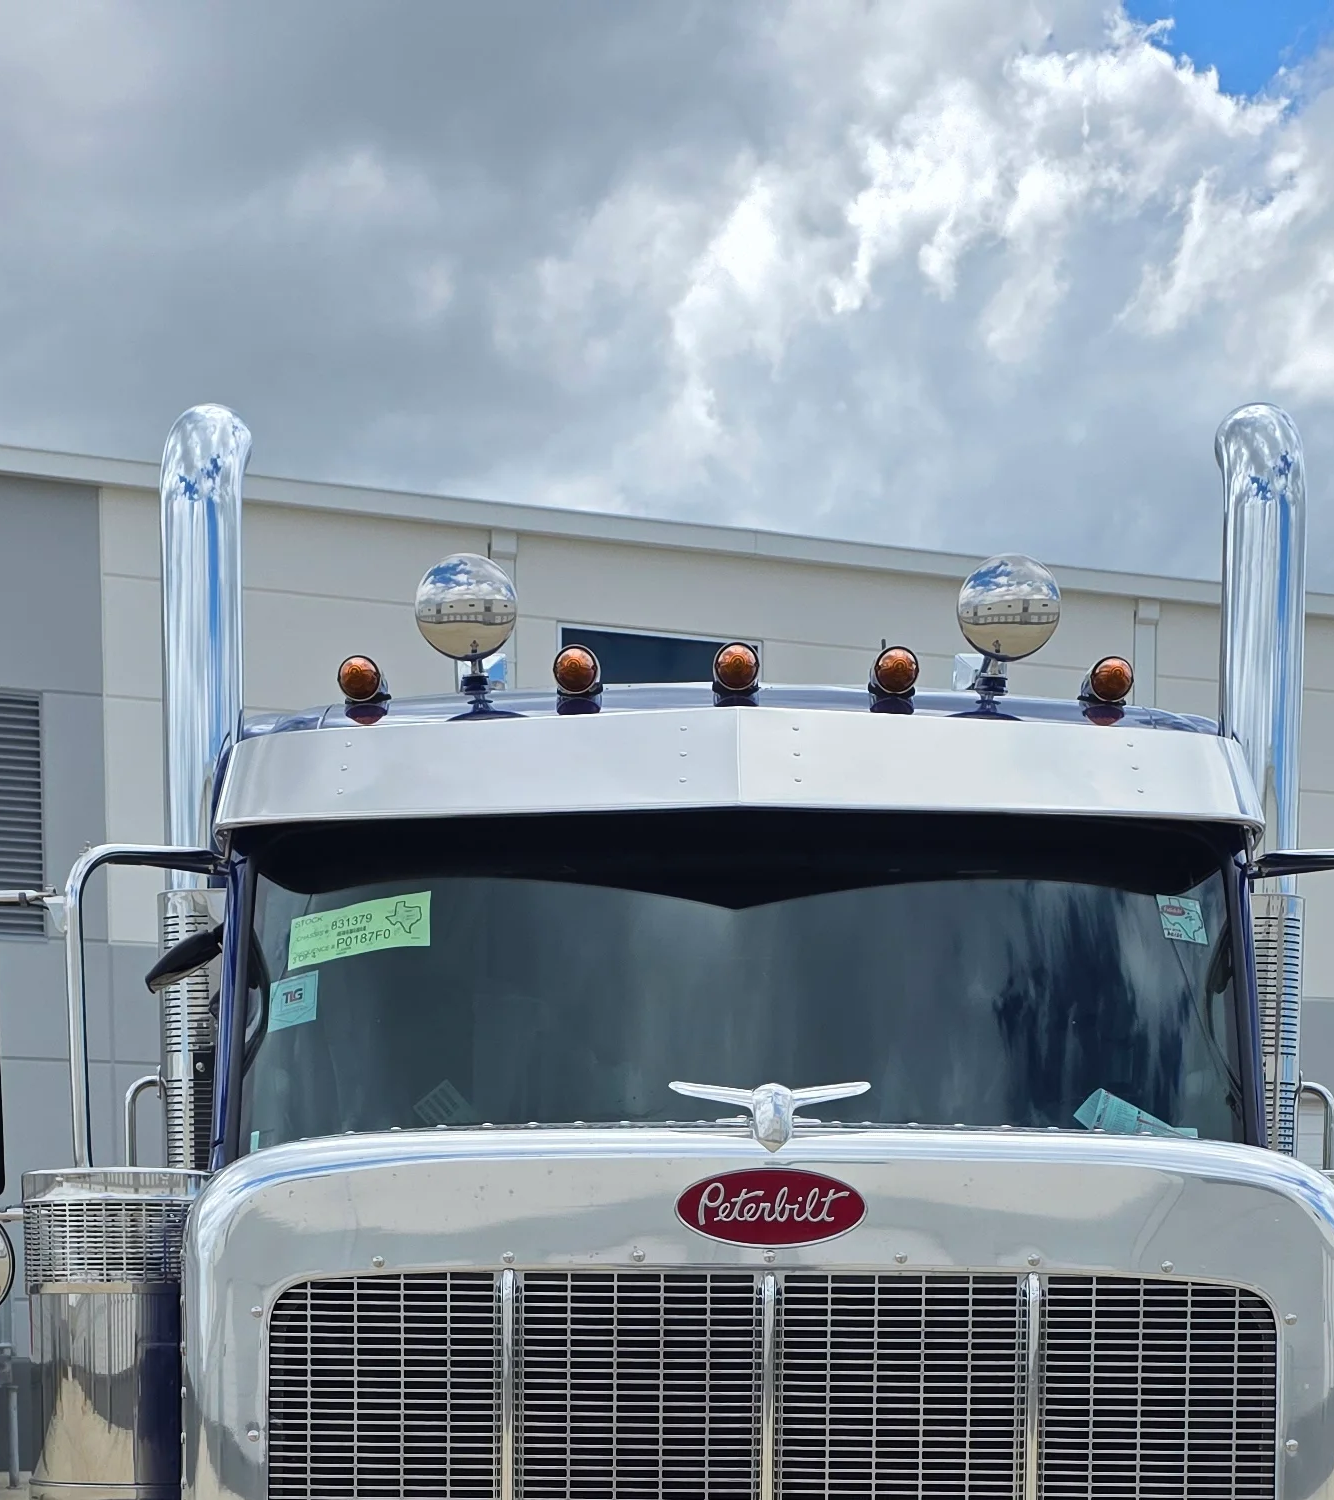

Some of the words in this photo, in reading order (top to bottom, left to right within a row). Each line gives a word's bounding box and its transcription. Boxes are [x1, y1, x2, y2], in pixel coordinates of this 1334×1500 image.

[331, 913, 373, 930] 831379
[336, 928, 391, 949] P0187F0
[282, 987, 303, 1004] TLG
[698, 1182, 849, 1225] Peterbilt
